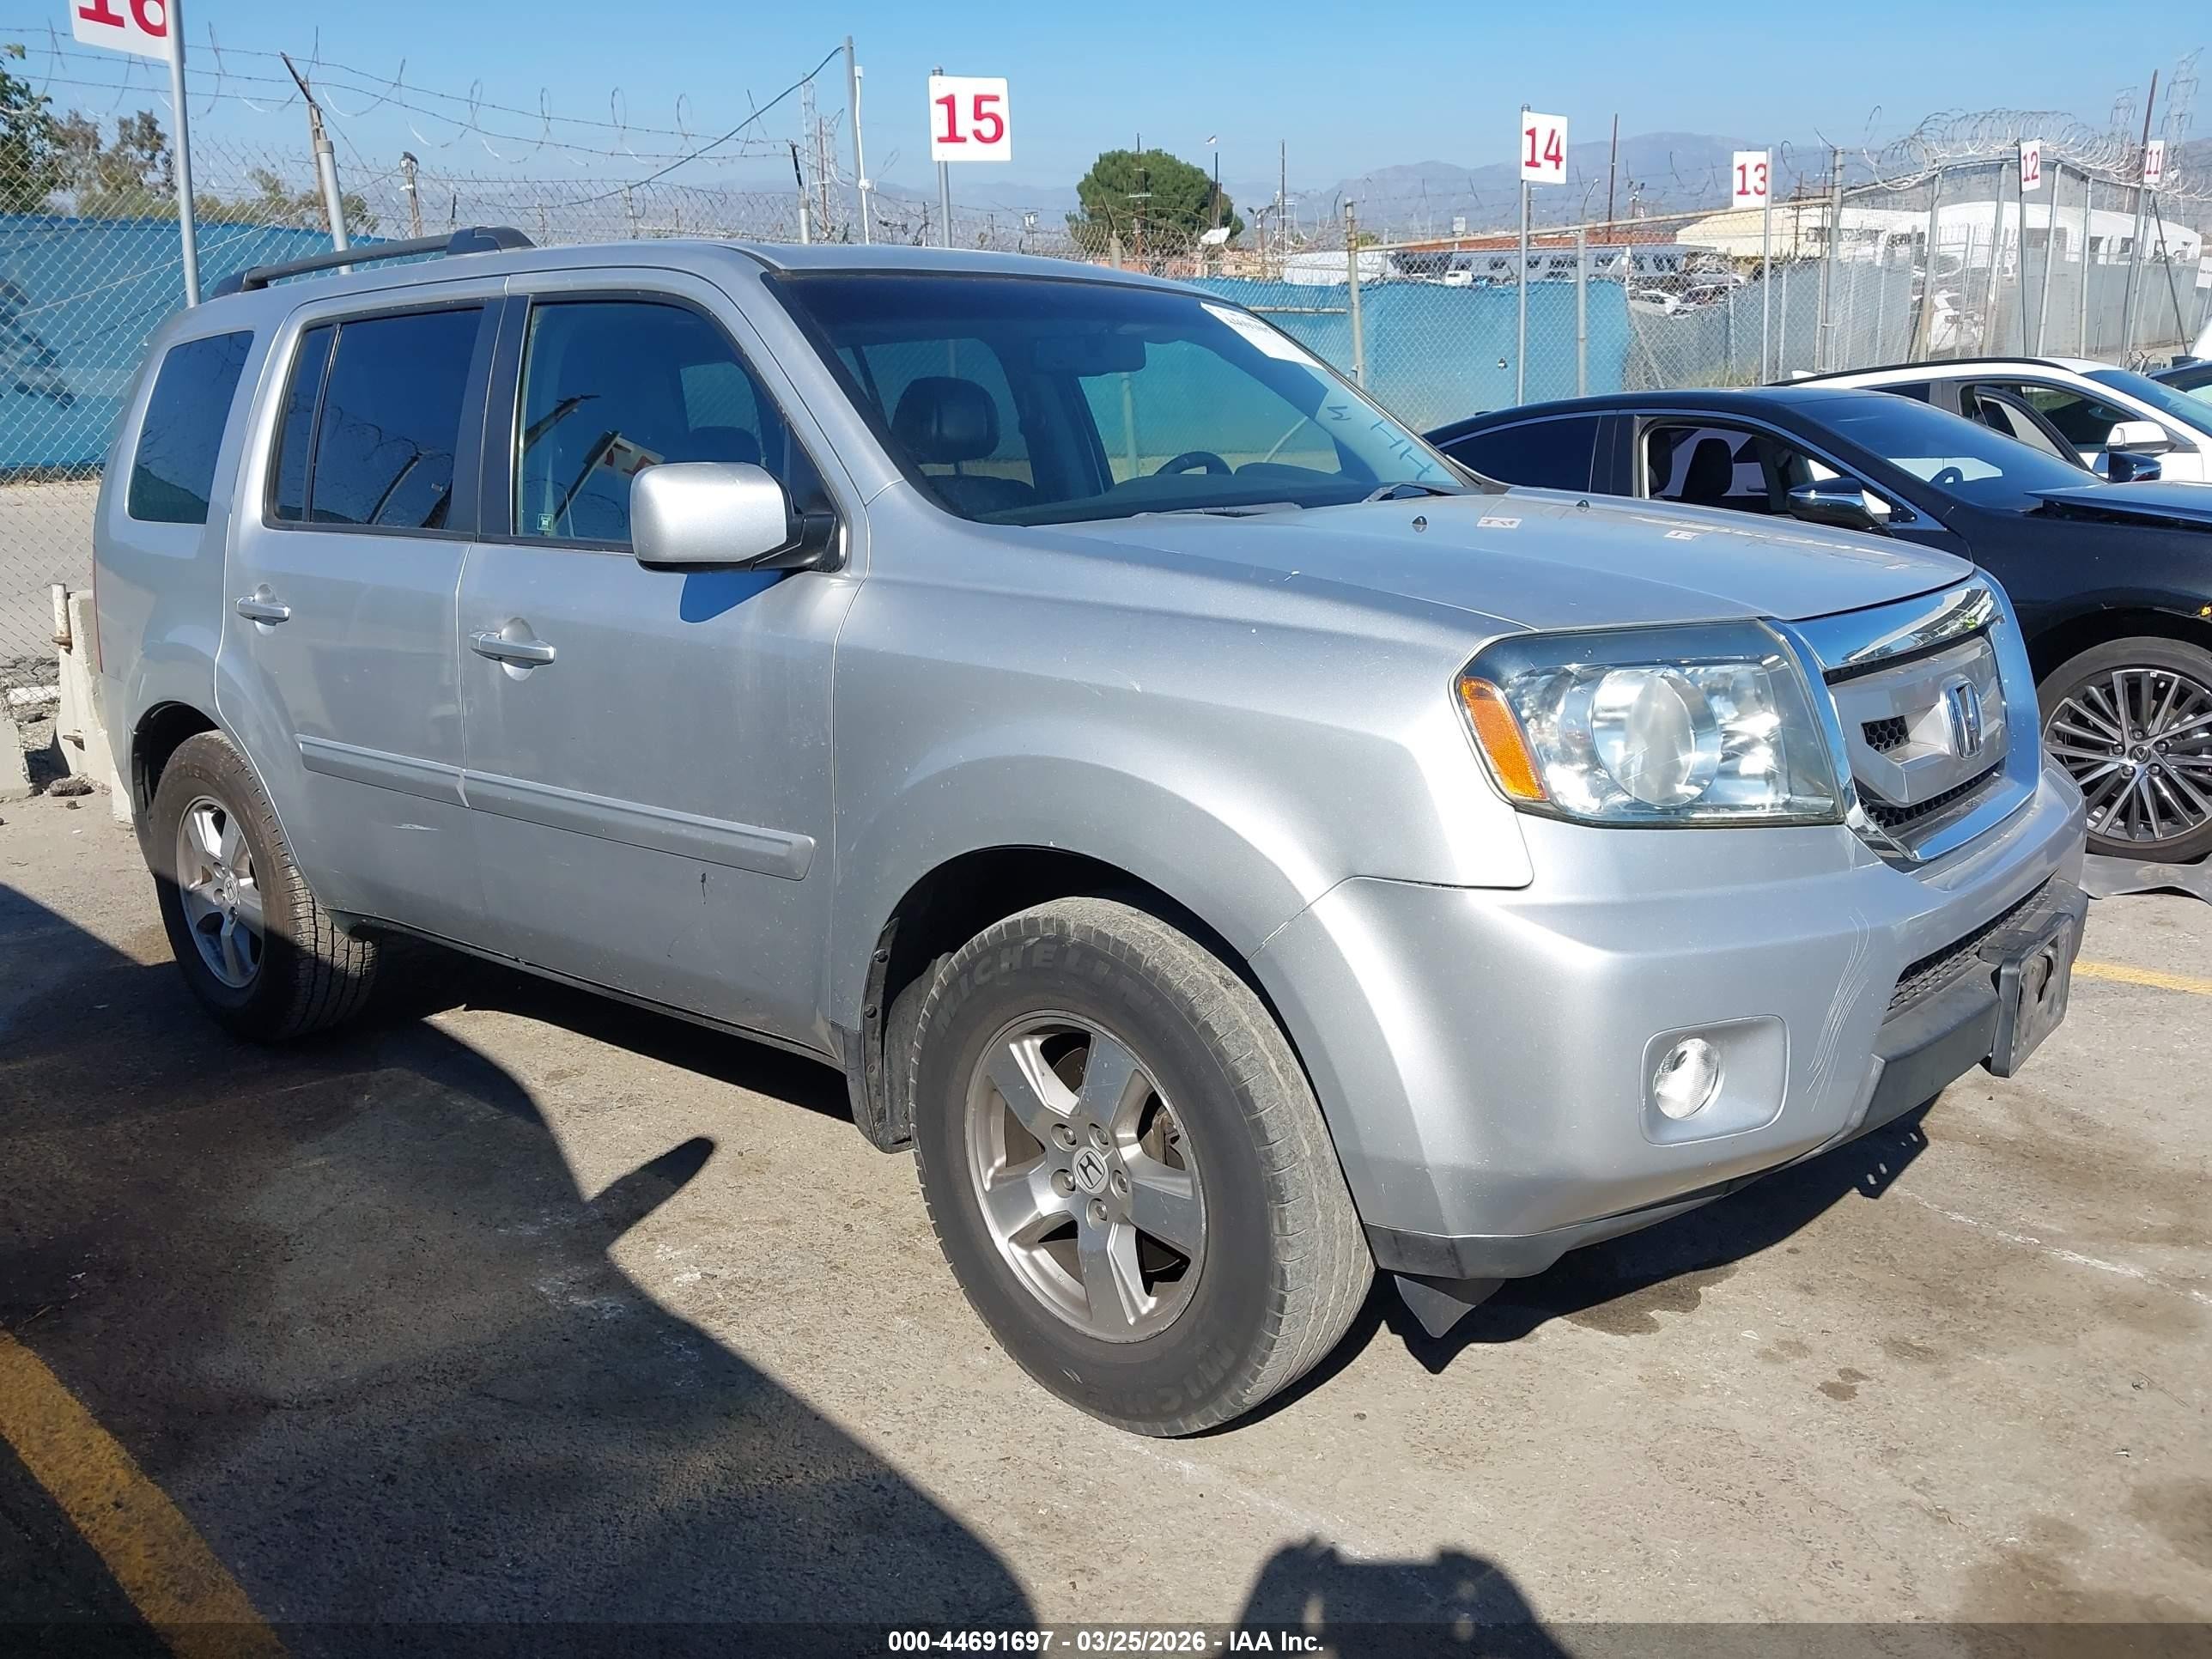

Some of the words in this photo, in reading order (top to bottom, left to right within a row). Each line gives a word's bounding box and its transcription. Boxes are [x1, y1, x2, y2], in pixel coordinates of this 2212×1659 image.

[936, 94, 1004, 144] 15
[1524, 126, 1563, 168] 14
[2145, 149, 2161, 175] 11
[1736, 162, 1767, 196] 13
[2022, 150, 2039, 182] 12
